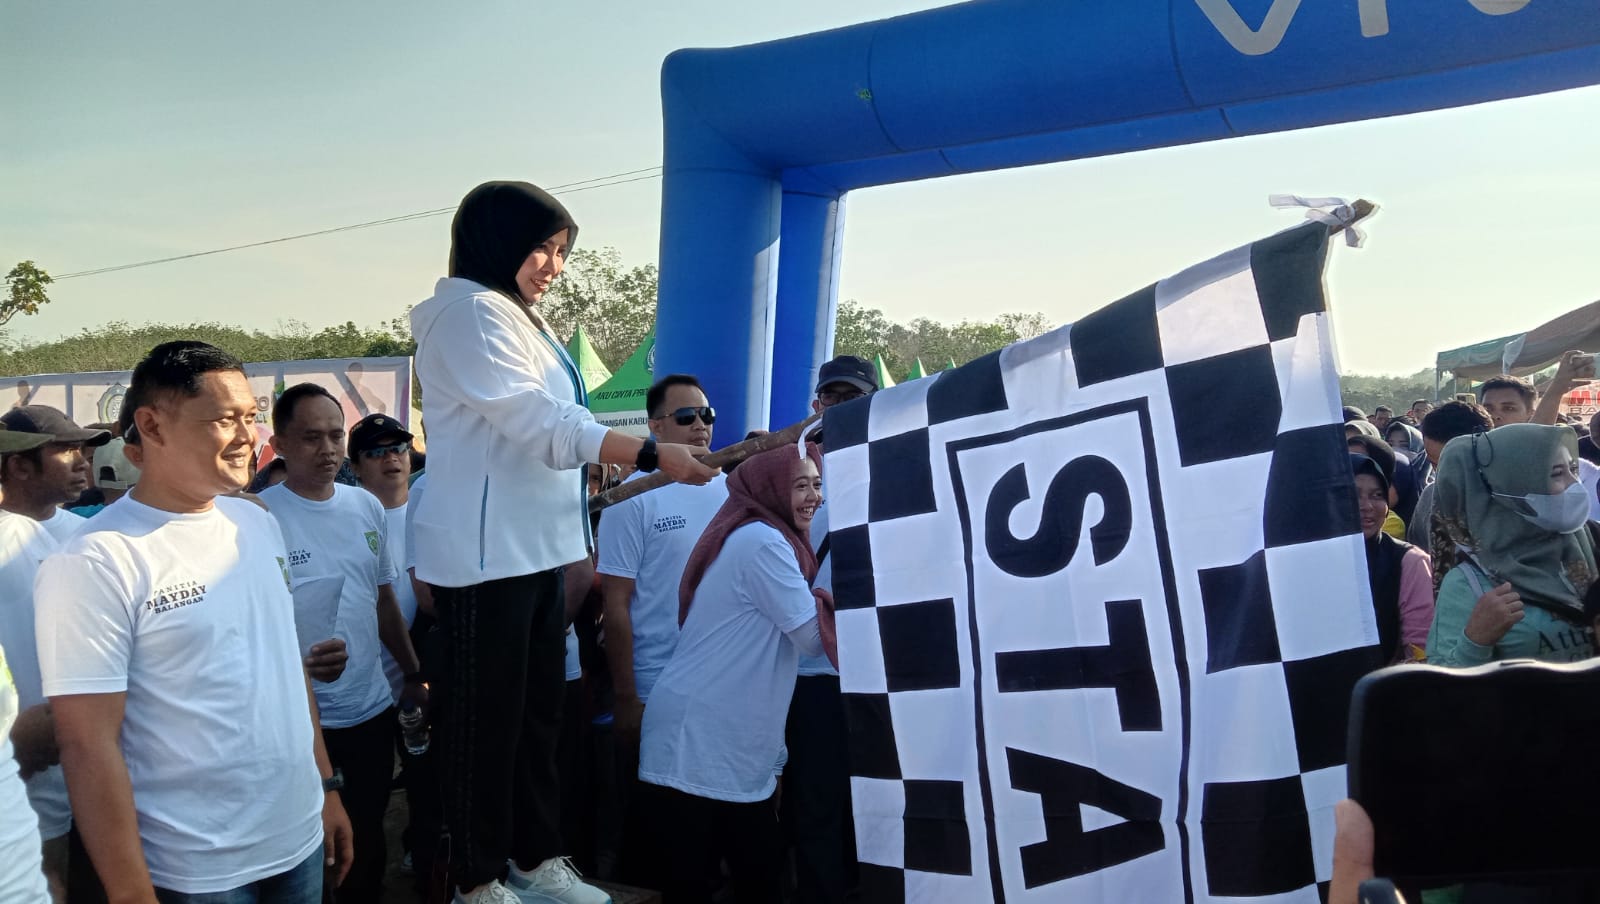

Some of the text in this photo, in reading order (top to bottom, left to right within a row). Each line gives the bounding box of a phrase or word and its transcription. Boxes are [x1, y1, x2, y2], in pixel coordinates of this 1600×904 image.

[594, 391, 611, 401] AKU
[611, 389, 633, 400] CINTA
[629, 416, 648, 426] KABU
[654, 519, 687, 530] MAYDAY
[146, 585, 207, 610] MAYDAY
[155, 596, 204, 614] BALANGAN
[984, 454, 1166, 890] STA
